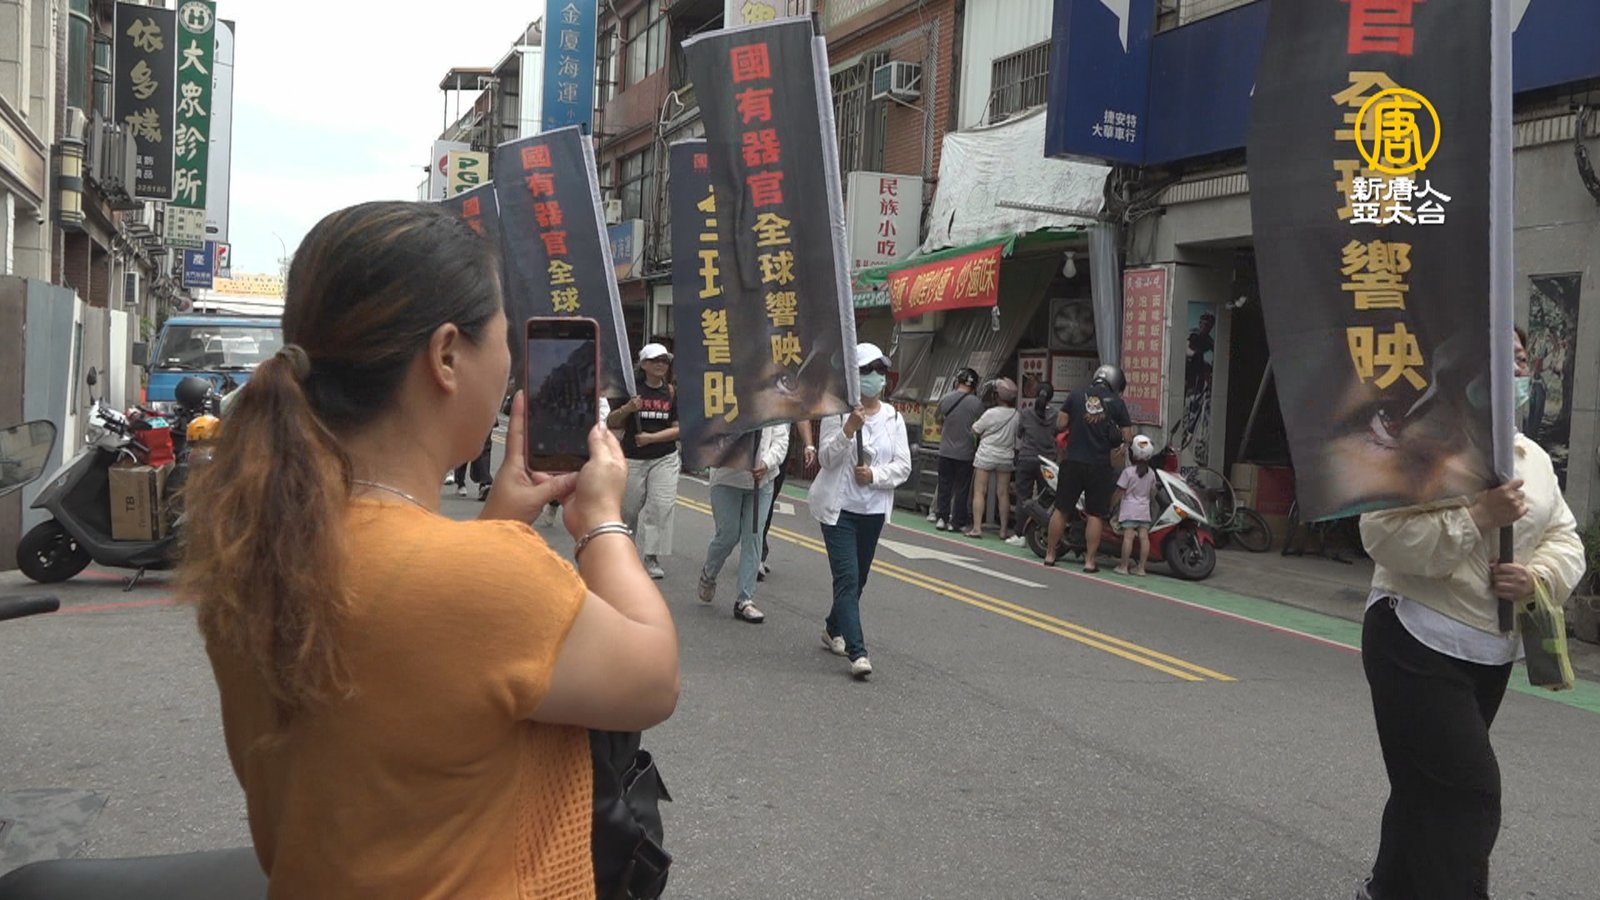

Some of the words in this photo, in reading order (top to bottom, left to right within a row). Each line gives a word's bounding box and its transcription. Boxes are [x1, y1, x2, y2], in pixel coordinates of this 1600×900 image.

[1091, 124, 1136, 143] 大華車行
[1104, 109, 1137, 128] 捷安特
[729, 42, 803, 367] 國有器官全球響映
[877, 177, 899, 257] 民族小吃
